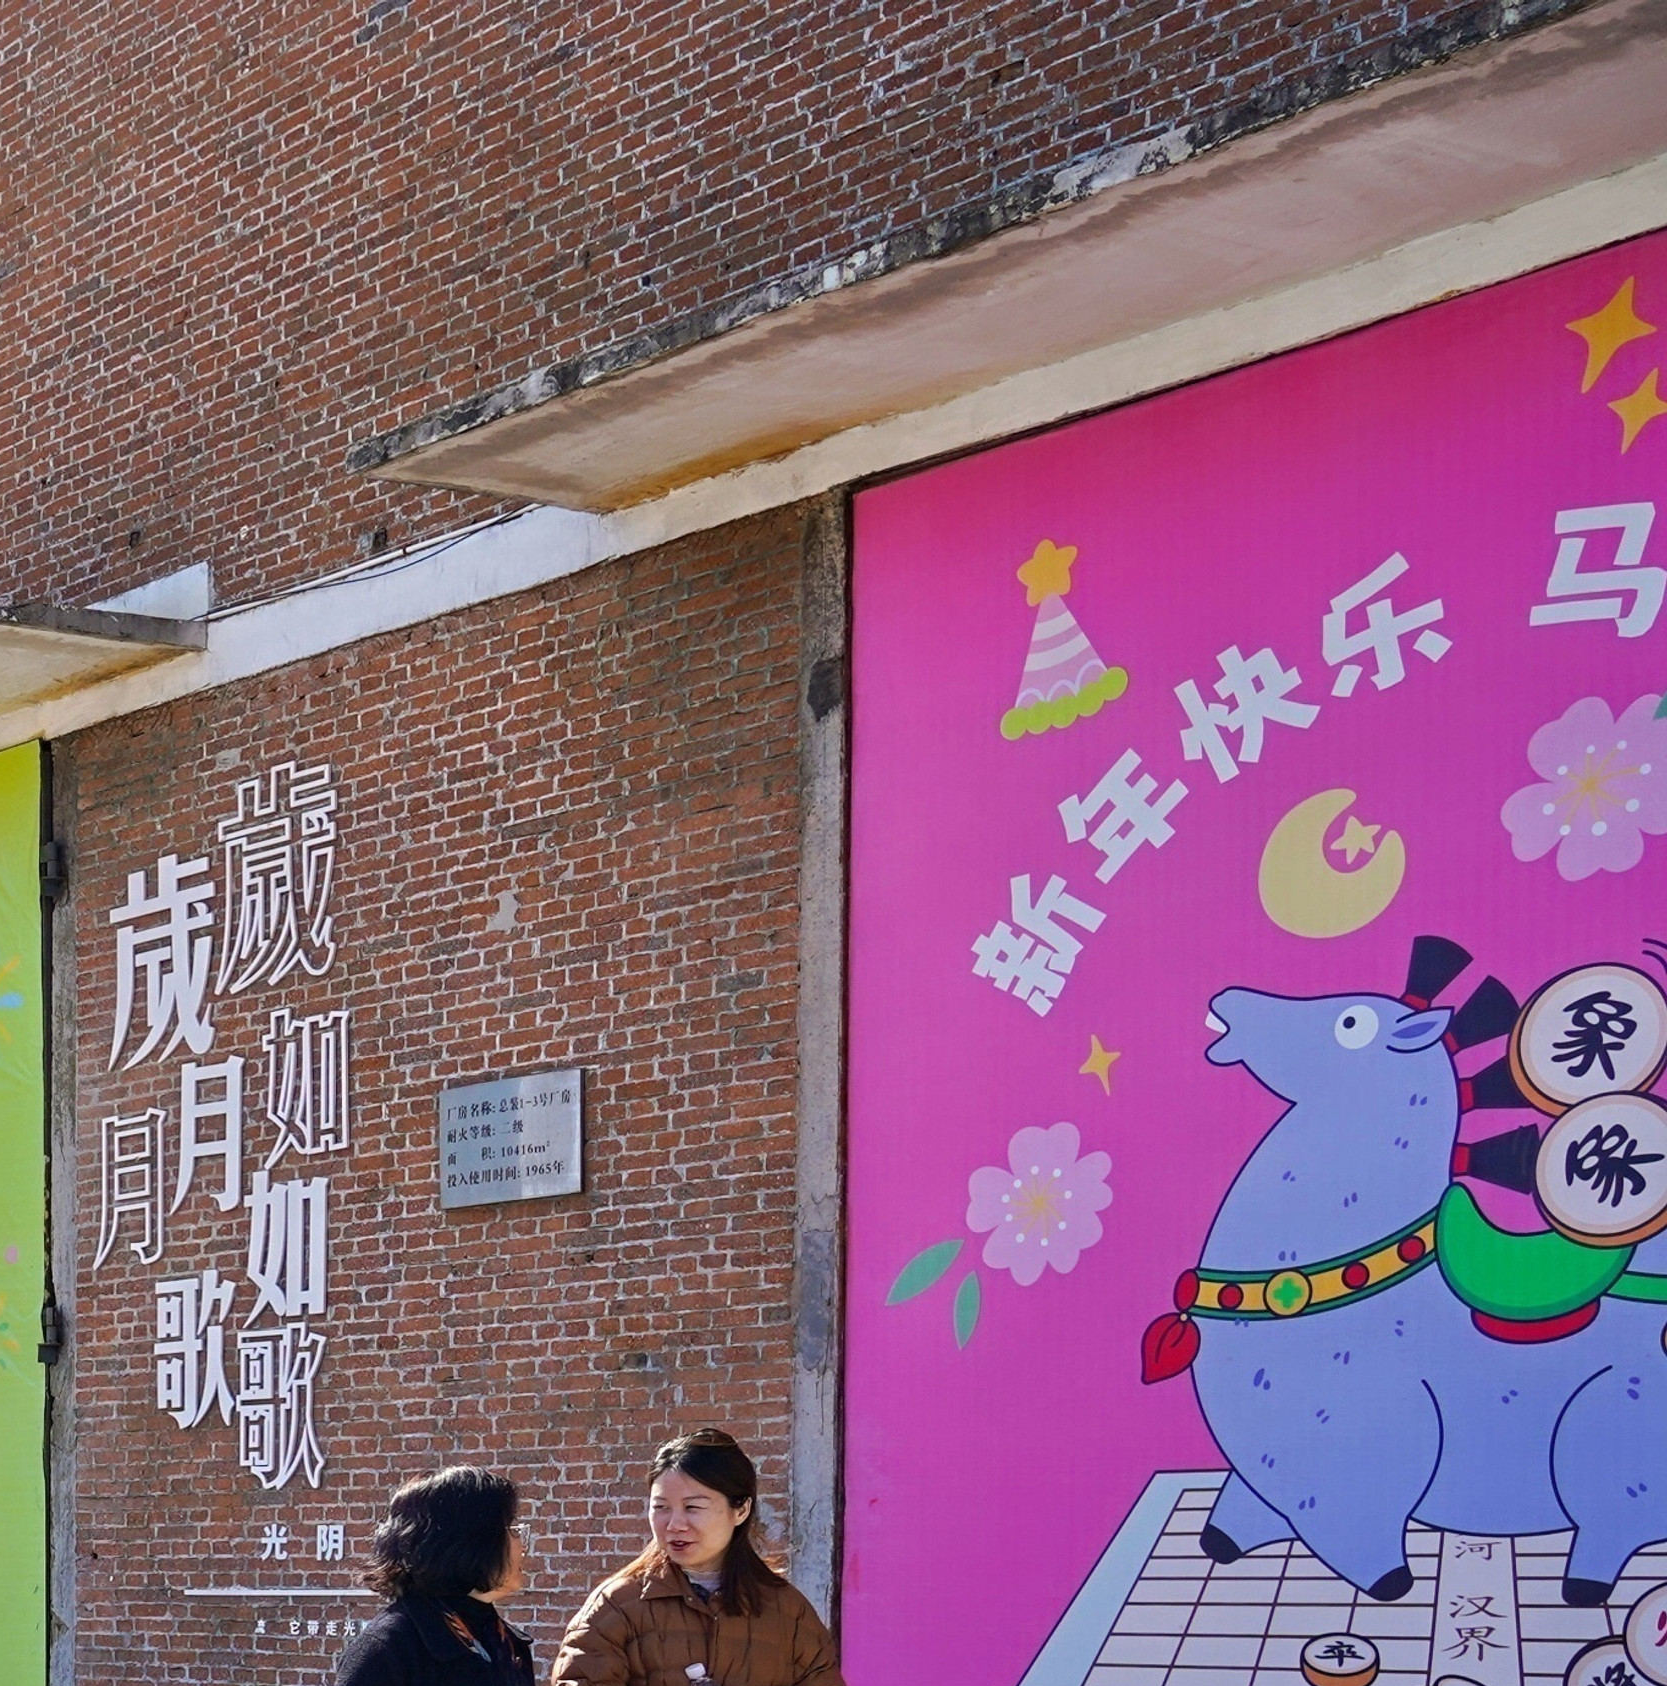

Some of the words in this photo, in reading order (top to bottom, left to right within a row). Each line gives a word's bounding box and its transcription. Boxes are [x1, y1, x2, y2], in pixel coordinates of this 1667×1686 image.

[970, 551, 1453, 1017] 新年快乐
[1528, 501, 1667, 639] 马
[260, 1523, 345, 1561] 光阴
[1454, 1540, 1503, 1562] 河
[1441, 1594, 1511, 1662] 汉界
